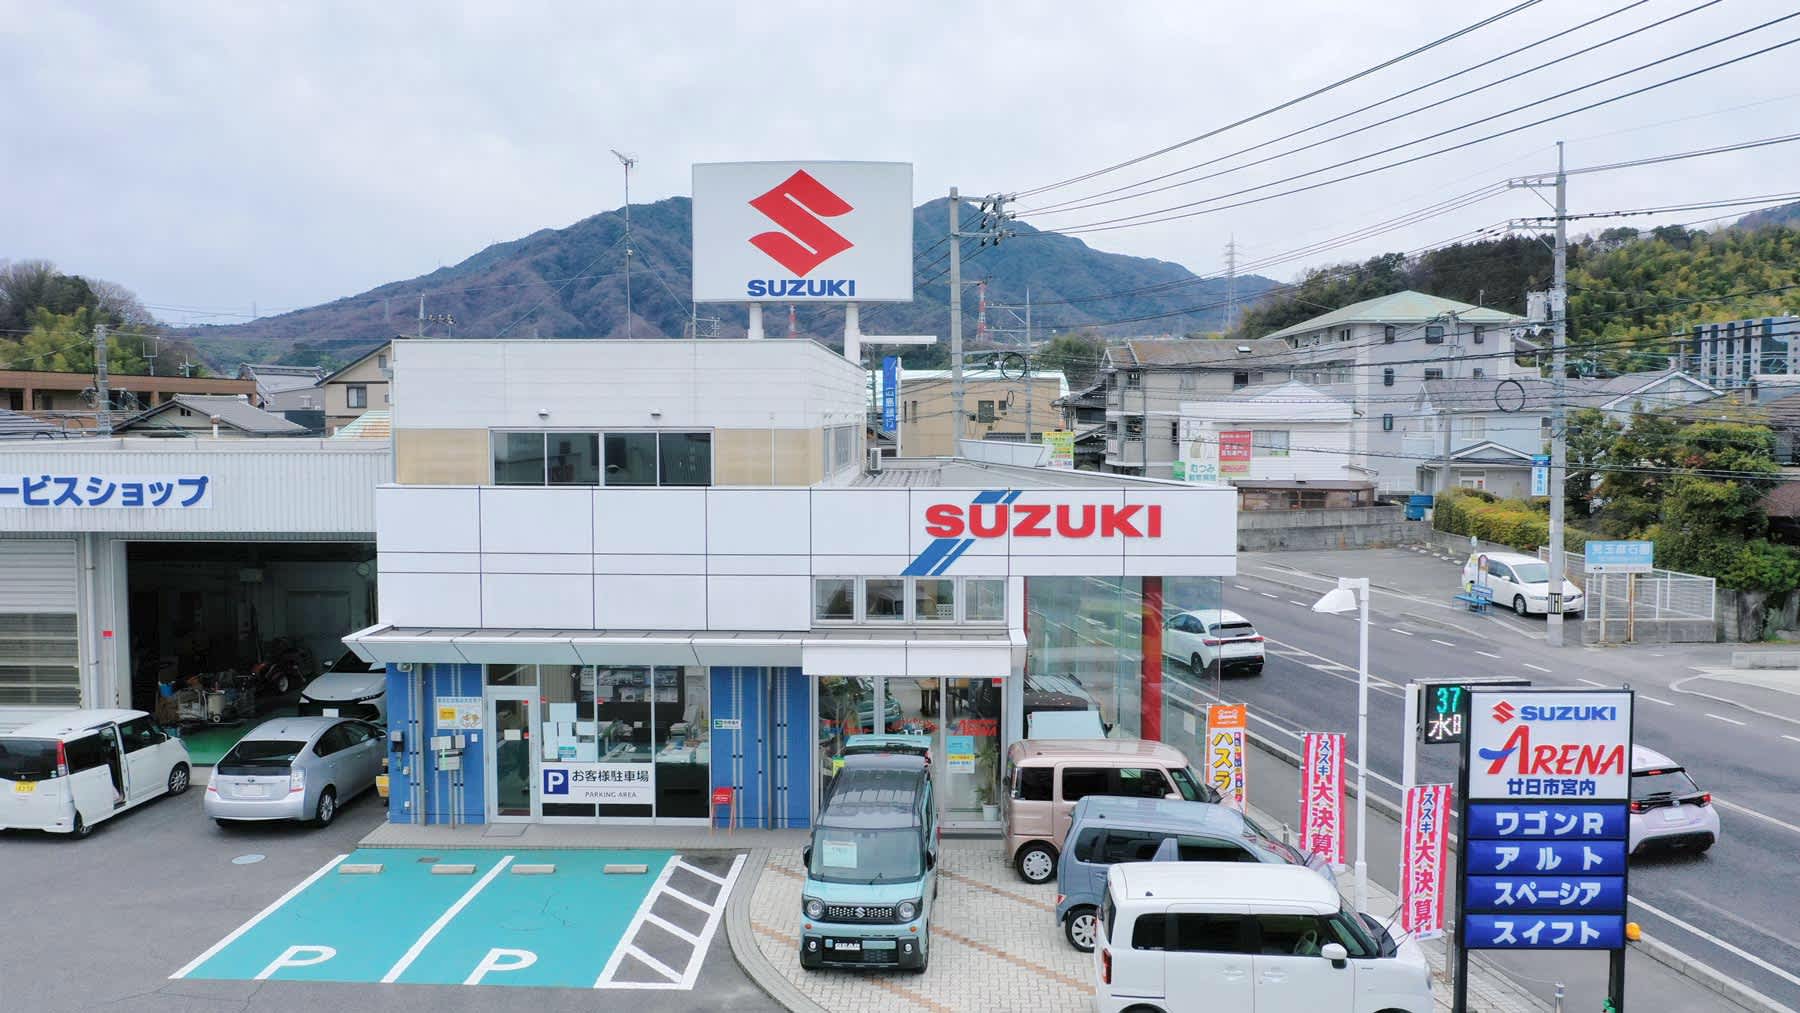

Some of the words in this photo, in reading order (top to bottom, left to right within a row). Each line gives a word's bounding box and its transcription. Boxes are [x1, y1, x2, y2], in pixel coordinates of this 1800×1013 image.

[747, 279, 855, 297] SUZUKI
[0, 475, 209, 507] ービスショップ
[925, 504, 1162, 539] SUZUKI
[1520, 705, 1617, 721] SUZUKI
[1478, 724, 1625, 775] ARENA
[548, 772, 564, 793] P
[572, 770, 649, 783] お客様駐車場
[1506, 778, 1596, 796] 廿日市宮内
[1495, 810, 1605, 836] ワゴンR
[1495, 846, 1604, 871] アルト
[1494, 881, 1601, 906] スペーシア
[1492, 920, 1601, 945] スイフト
[254, 945, 337, 980] P
[462, 948, 538, 986] P
